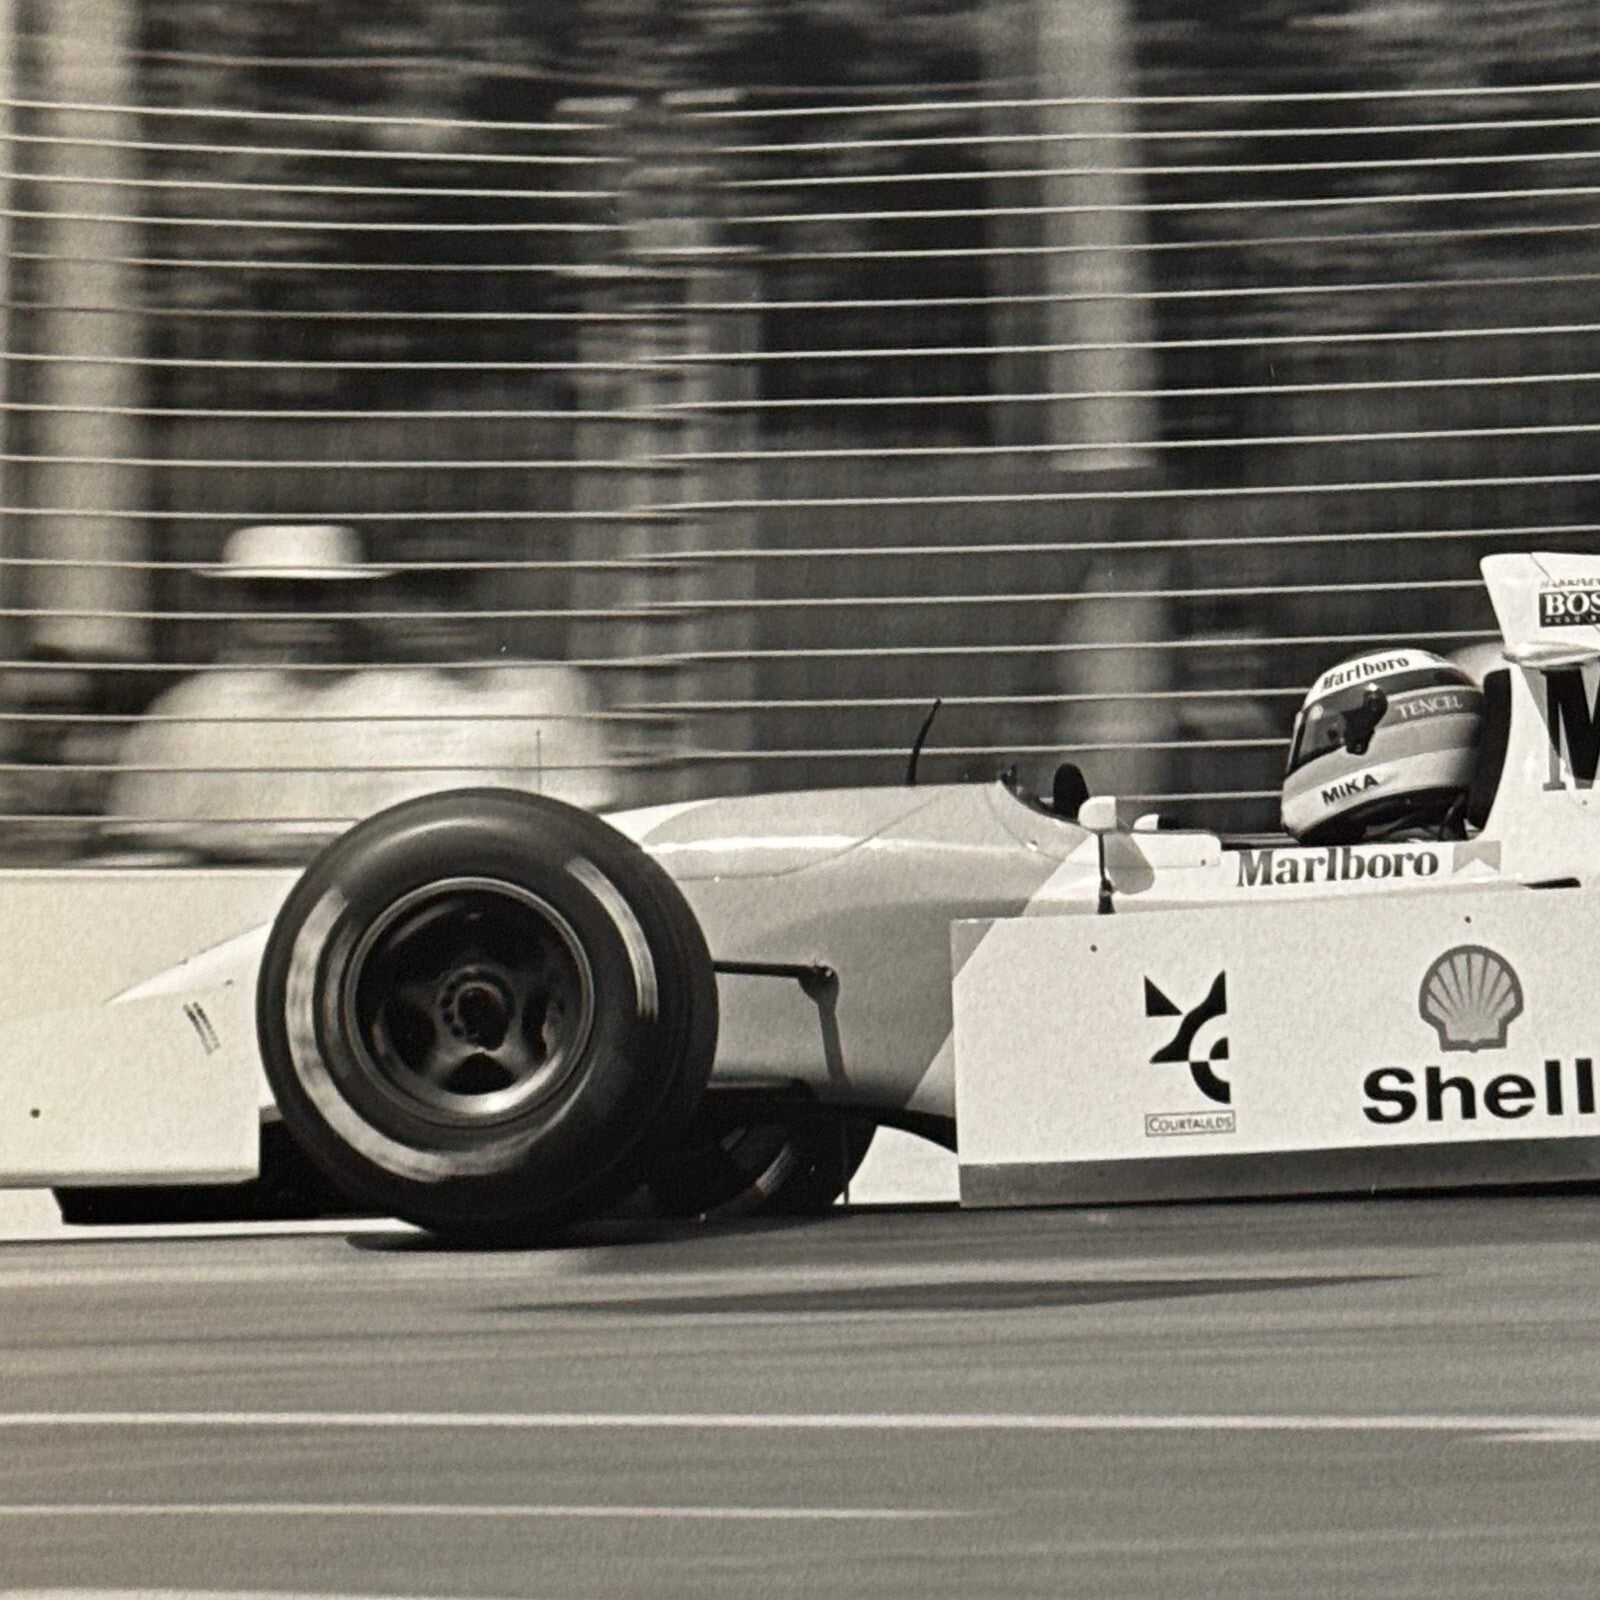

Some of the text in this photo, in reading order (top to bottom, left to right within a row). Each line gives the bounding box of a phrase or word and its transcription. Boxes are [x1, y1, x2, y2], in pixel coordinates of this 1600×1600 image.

[1323, 658, 1409, 689] Marlboro
[1321, 774, 1380, 806] MIKA
[1236, 847, 1439, 887] Marlboro
[1362, 1058, 1595, 1124] Shell
